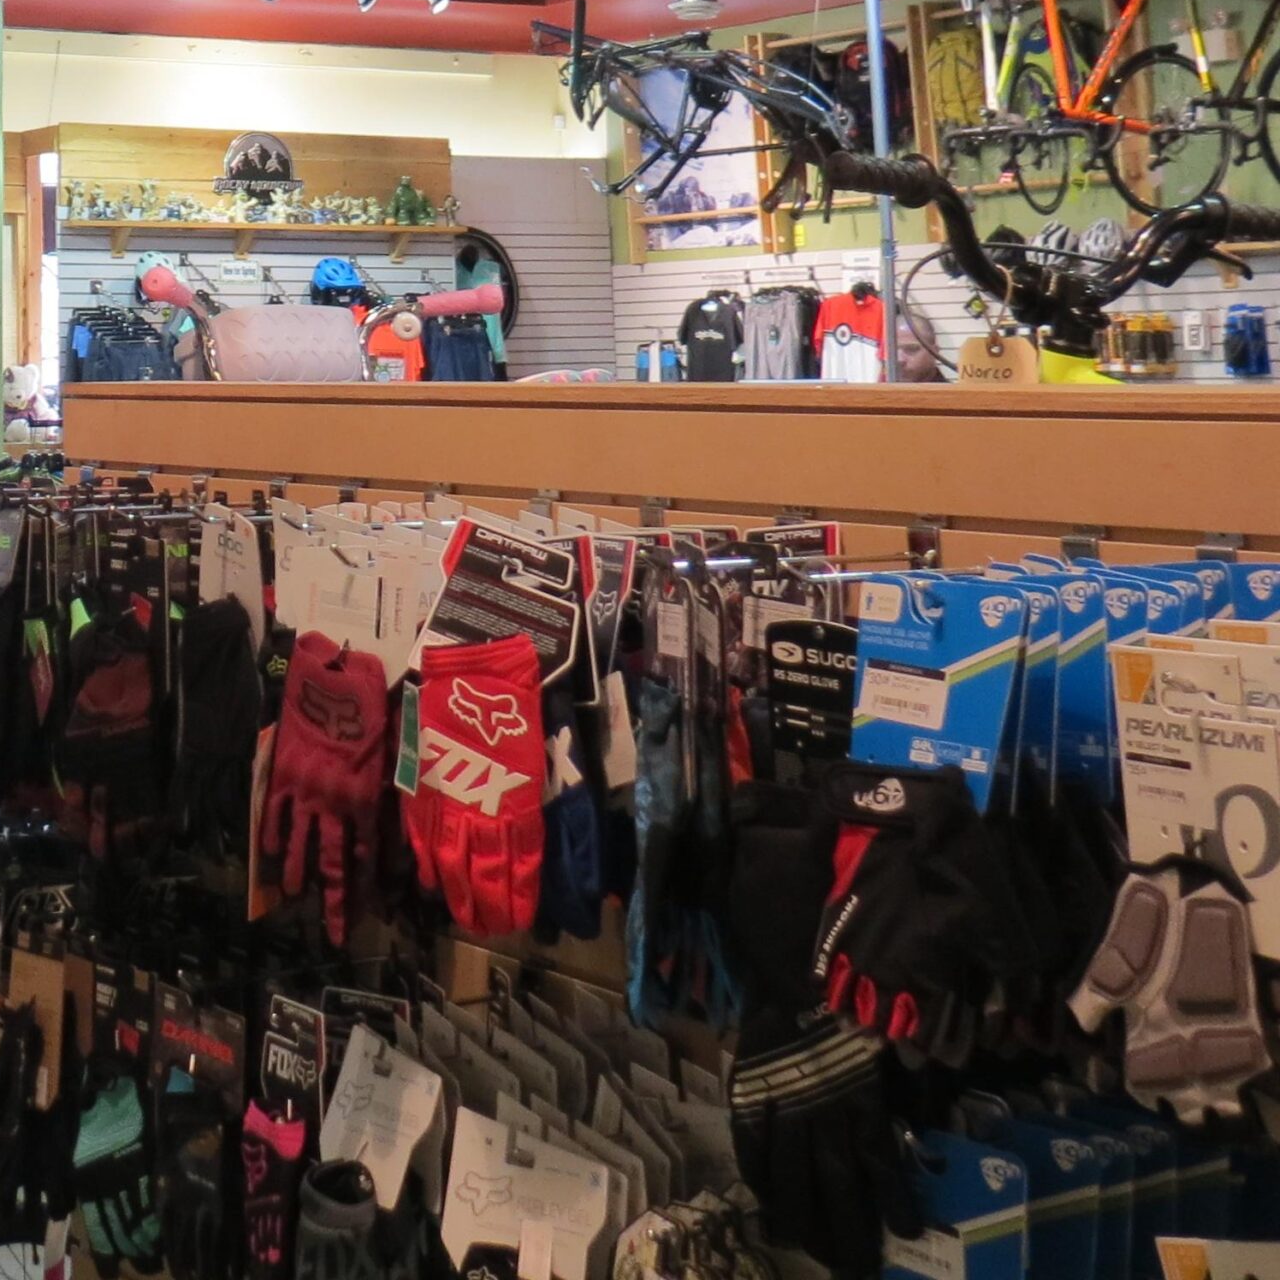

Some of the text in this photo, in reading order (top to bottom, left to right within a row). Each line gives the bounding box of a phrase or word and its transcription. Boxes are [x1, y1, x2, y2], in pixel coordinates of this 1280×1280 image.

[960, 363, 1013, 379] Norco
[475, 527, 549, 561] DIRTPAW
[811, 673, 840, 691] GLOVE
[1126, 717, 1194, 743] PEARL
[420, 726, 532, 817] FOX
[268, 1041, 297, 1083] FOX
